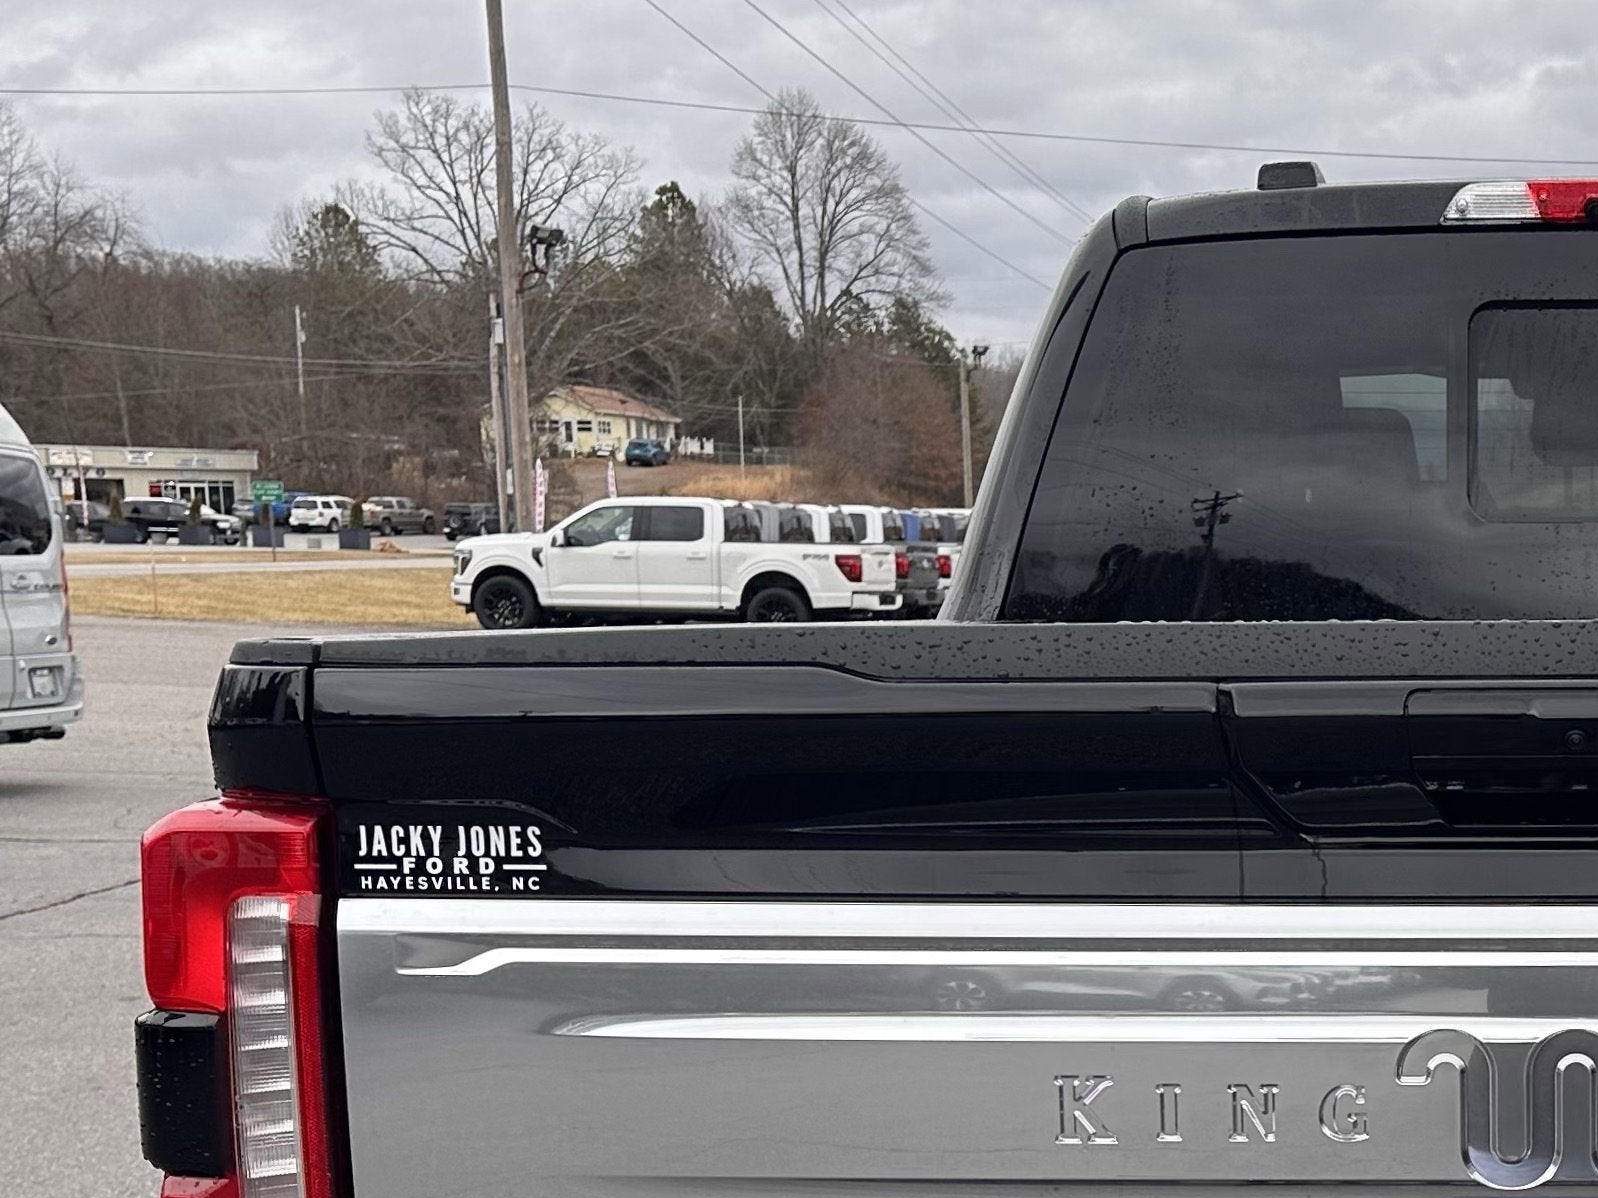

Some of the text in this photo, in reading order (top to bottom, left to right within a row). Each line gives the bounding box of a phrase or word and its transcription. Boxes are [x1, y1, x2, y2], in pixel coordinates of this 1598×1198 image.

[358, 824, 542, 858] JACKY JONES
[402, 856, 496, 875] FORD
[361, 875, 541, 892] HAYESVILLE, NC
[1053, 1074, 1371, 1145] KING
